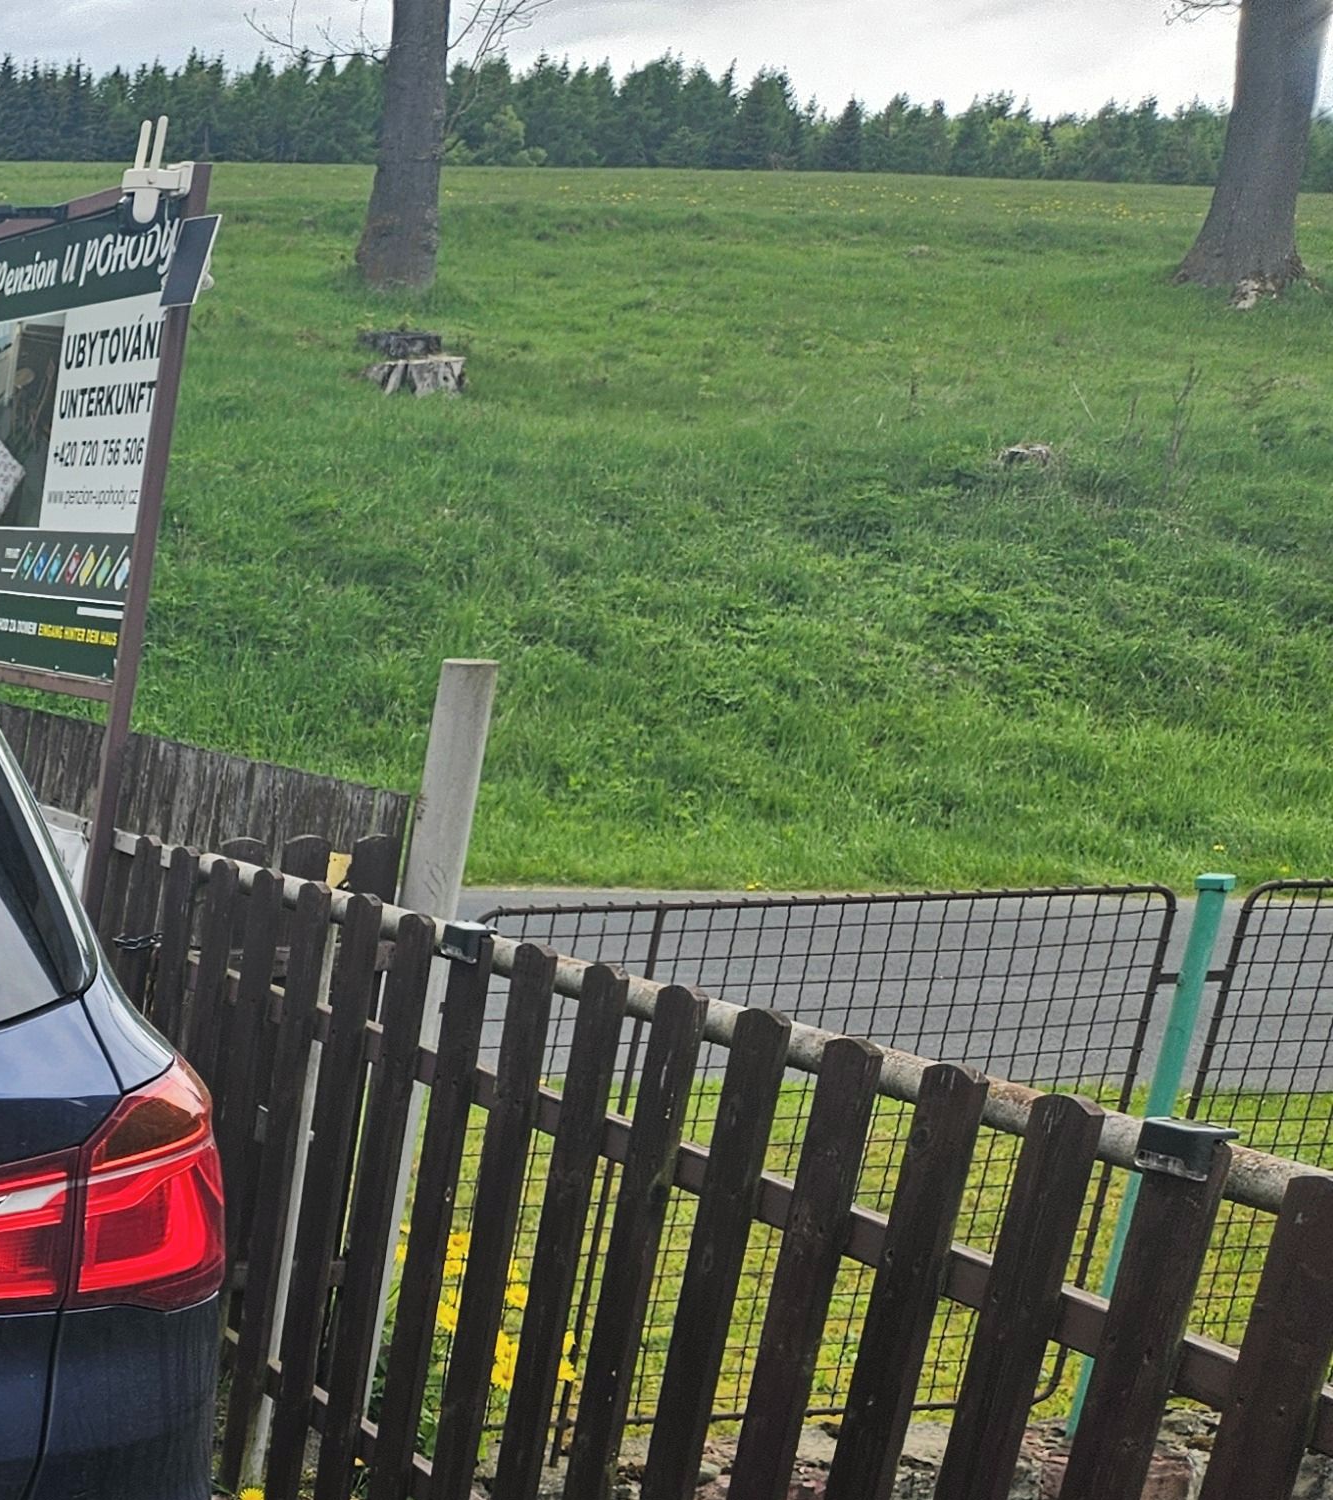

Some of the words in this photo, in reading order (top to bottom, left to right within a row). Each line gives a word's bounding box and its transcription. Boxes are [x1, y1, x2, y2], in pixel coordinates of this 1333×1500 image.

[61, 243, 81, 285] U
[79, 217, 180, 287] POHODY
[64, 309, 167, 370] UBYTOVÁNÍ
[59, 380, 157, 419] UNTERKUNFT
[53, 441, 77, 467] +420
[79, 440, 98, 466] 720
[100, 438, 121, 466] 756
[123, 437, 145, 465] 506
